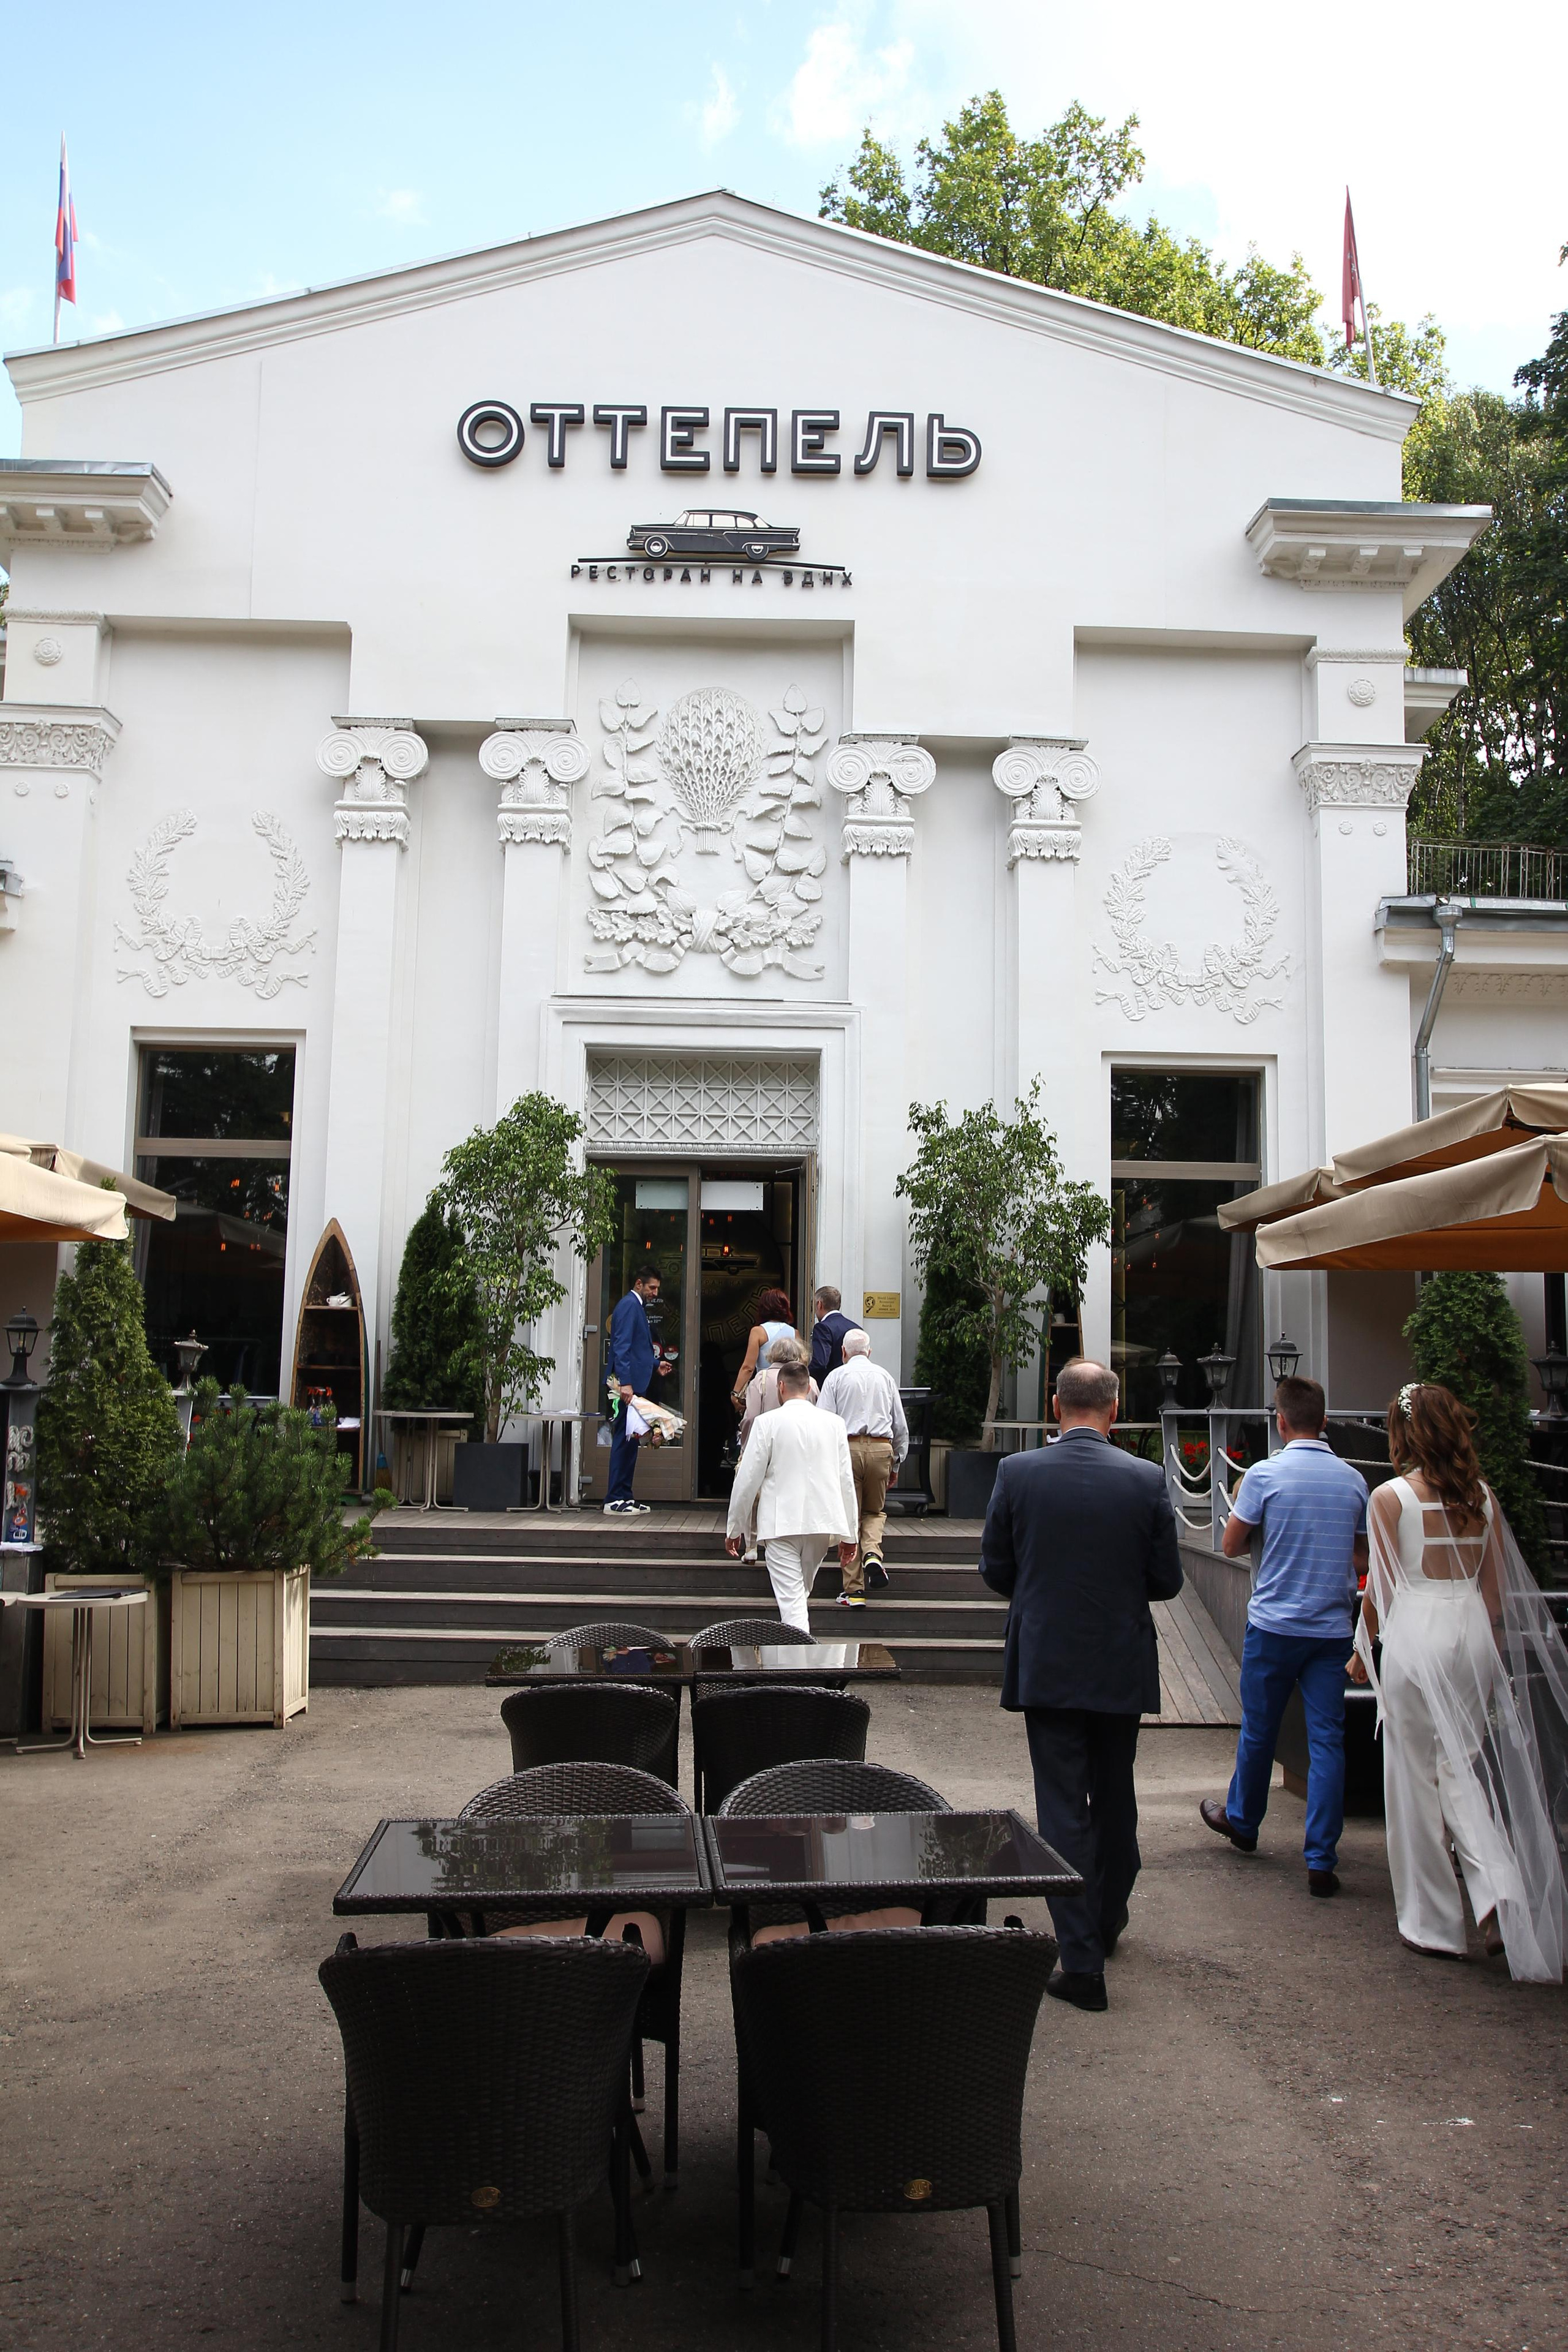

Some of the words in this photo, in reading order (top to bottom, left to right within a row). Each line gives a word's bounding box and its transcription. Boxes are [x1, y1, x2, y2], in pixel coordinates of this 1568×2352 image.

[457, 400, 982, 479] ОТТЕПЕЛЬ
[571, 565, 710, 583] РЕСТОРАН
[733, 570, 763, 584] НА
[783, 570, 853, 588] ВДНХ
